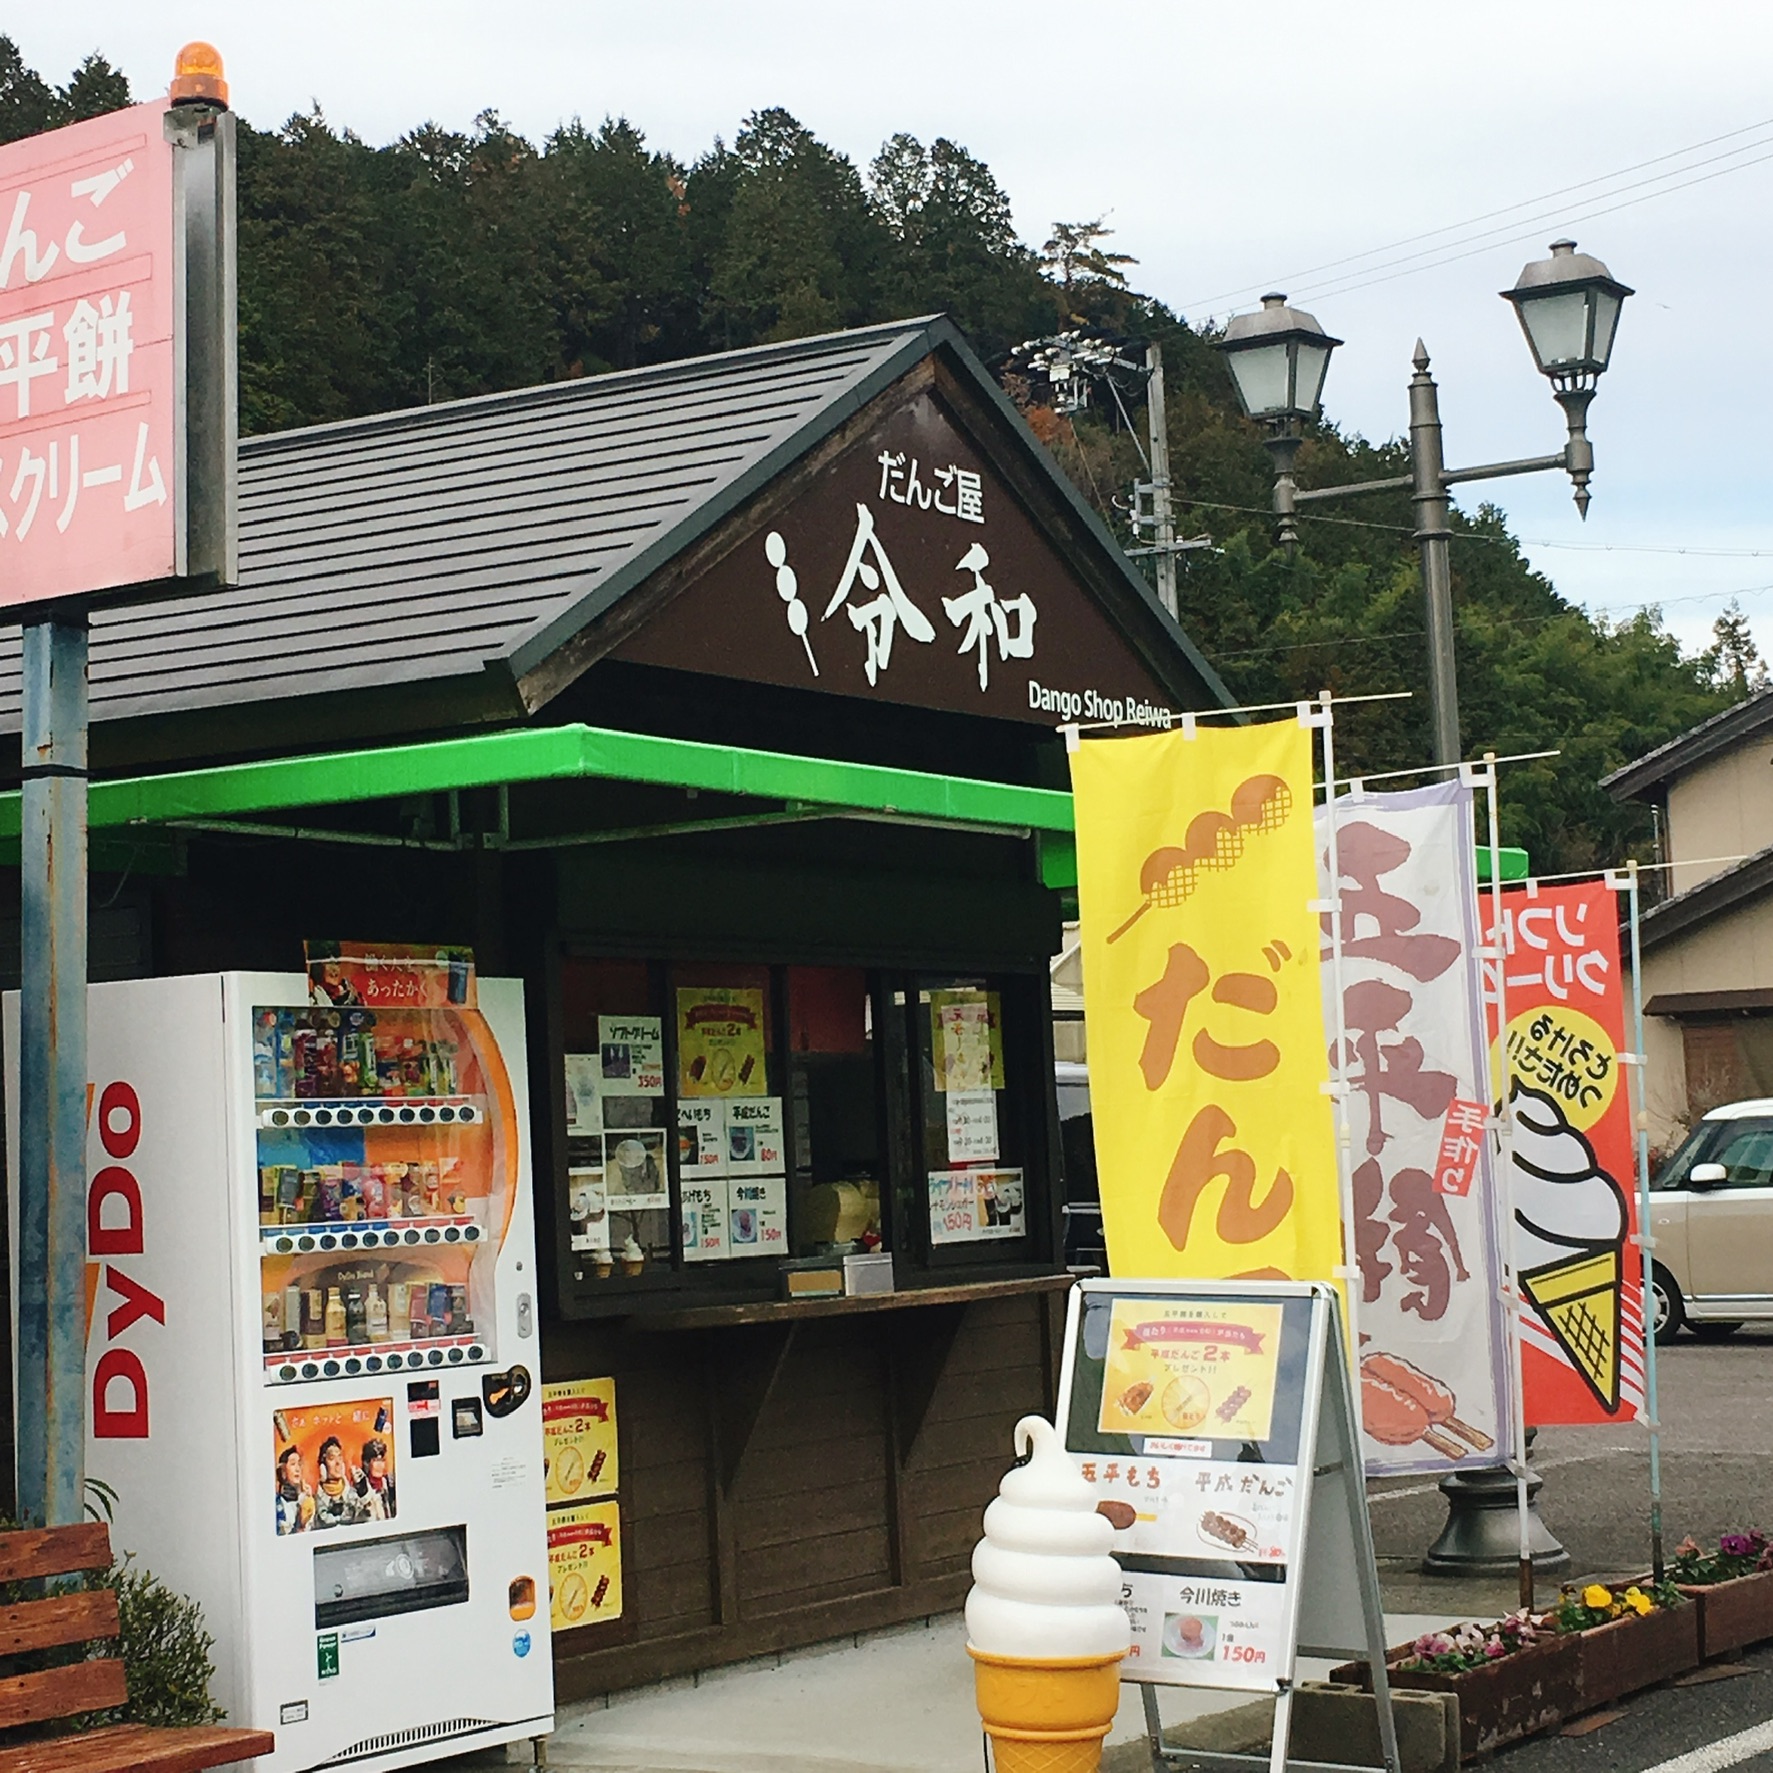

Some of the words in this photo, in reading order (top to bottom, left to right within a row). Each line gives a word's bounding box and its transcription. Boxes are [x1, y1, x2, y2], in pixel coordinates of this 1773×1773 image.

[877, 450, 985, 524] だんご屋
[821, 503, 1037, 692] 令和
[1029, 680, 1081, 721] Dango
[1084, 689, 1123, 728] Shop
[1126, 696, 1171, 729] Reiwa
[1133, 941, 1293, 1278] だん
[1180, 1586, 1242, 1607] 今川焼き
[1222, 1645, 1266, 1664] 150円
